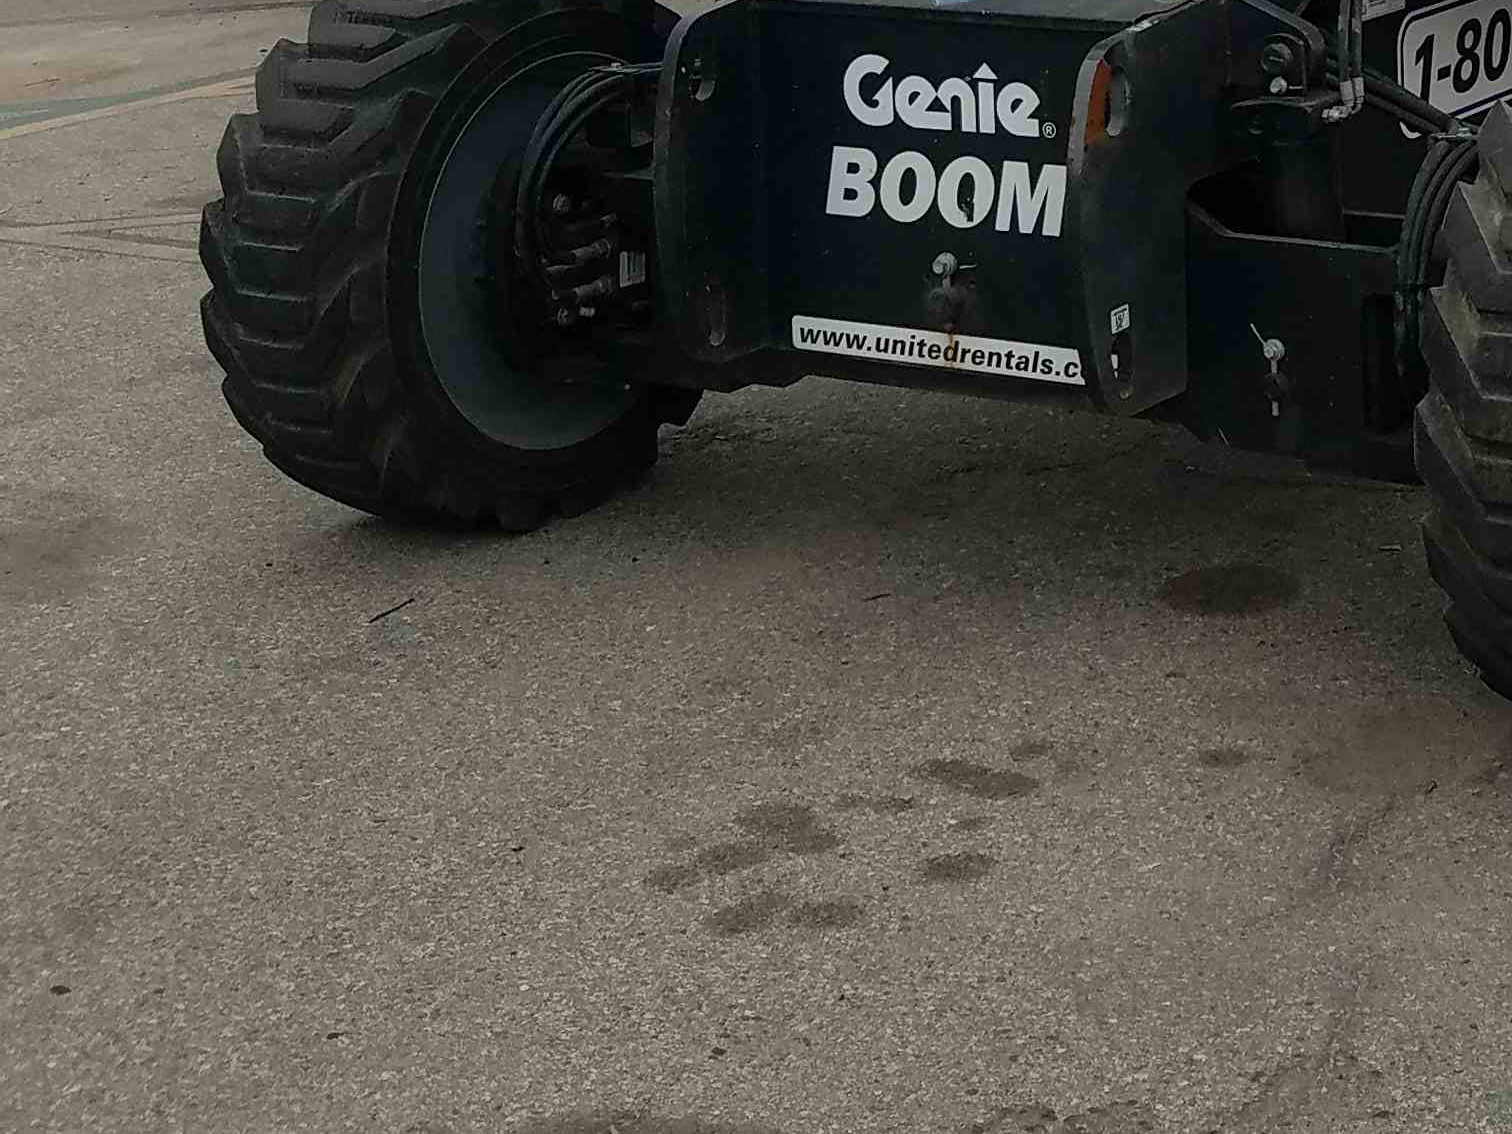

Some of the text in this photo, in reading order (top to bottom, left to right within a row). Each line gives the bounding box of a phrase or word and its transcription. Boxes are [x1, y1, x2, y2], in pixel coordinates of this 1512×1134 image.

[843, 53, 1041, 138] Genie
[825, 145, 1068, 238] BOOM
[799, 326, 1085, 379] www.unitedrentals.c
